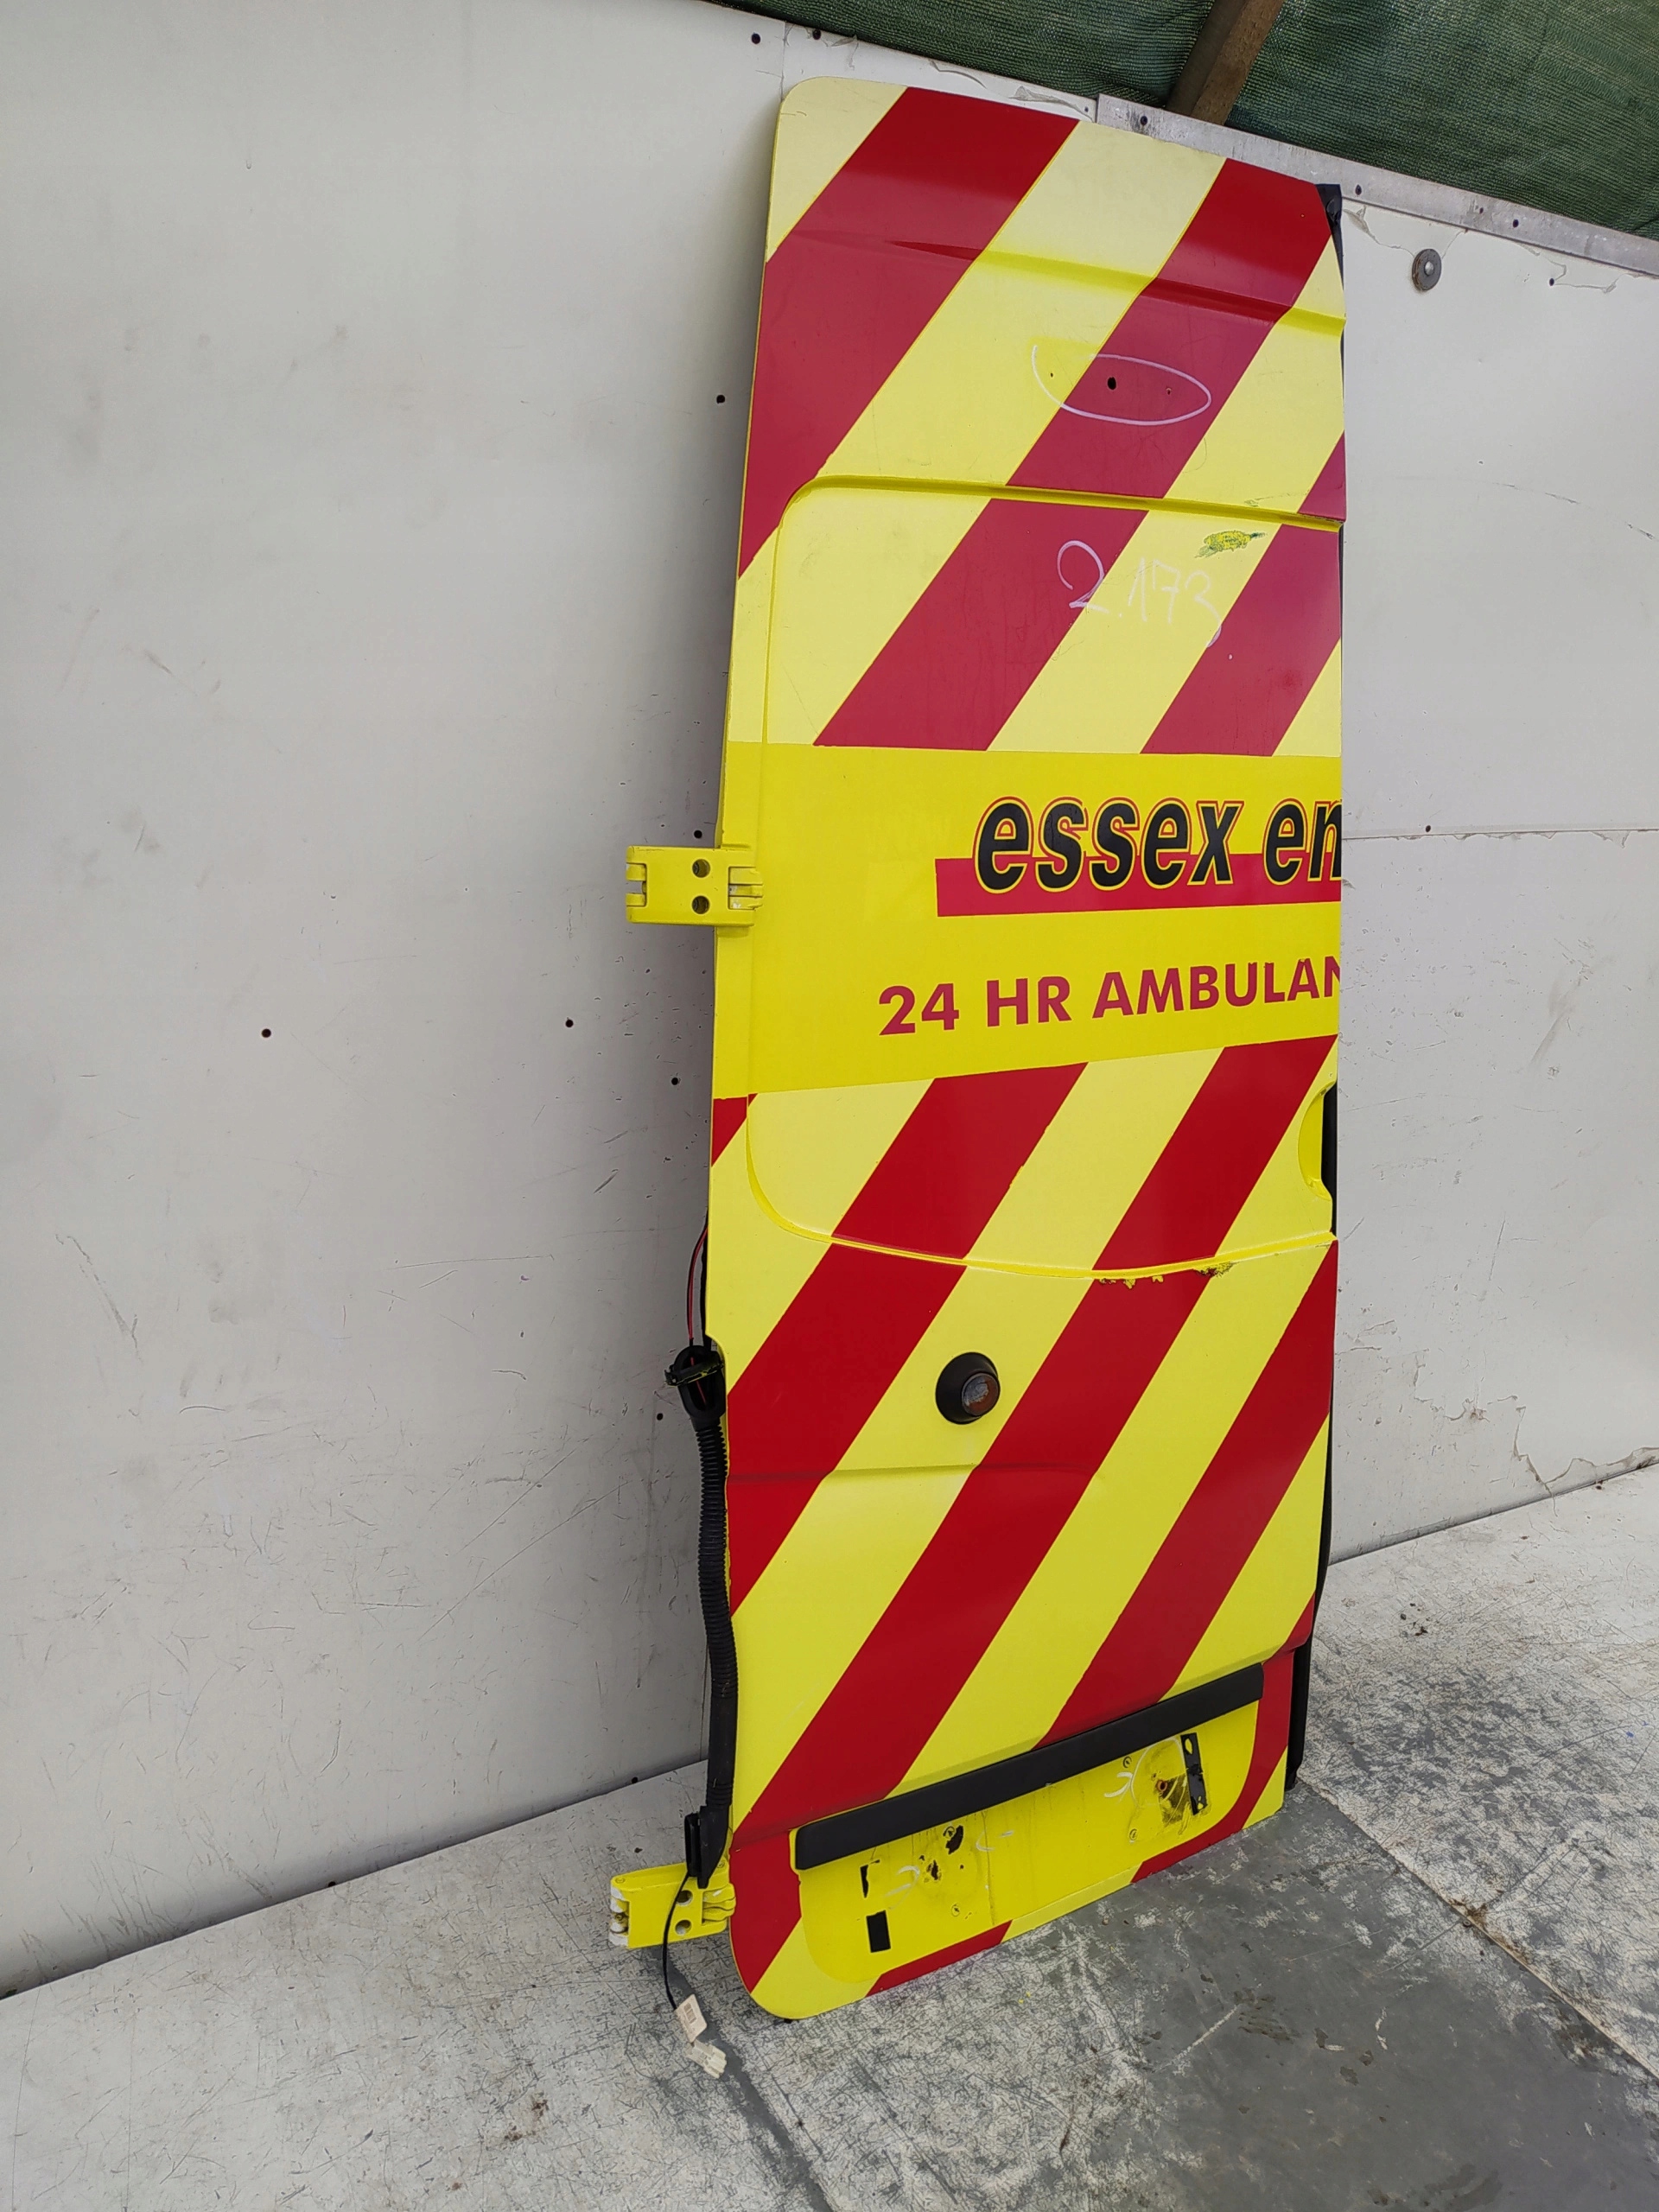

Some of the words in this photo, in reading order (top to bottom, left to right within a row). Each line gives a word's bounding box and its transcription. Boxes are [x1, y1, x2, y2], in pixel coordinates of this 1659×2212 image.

[973, 796, 1244, 893] essex
[879, 982, 959, 1036] 24
[987, 976, 1071, 1027] HR
